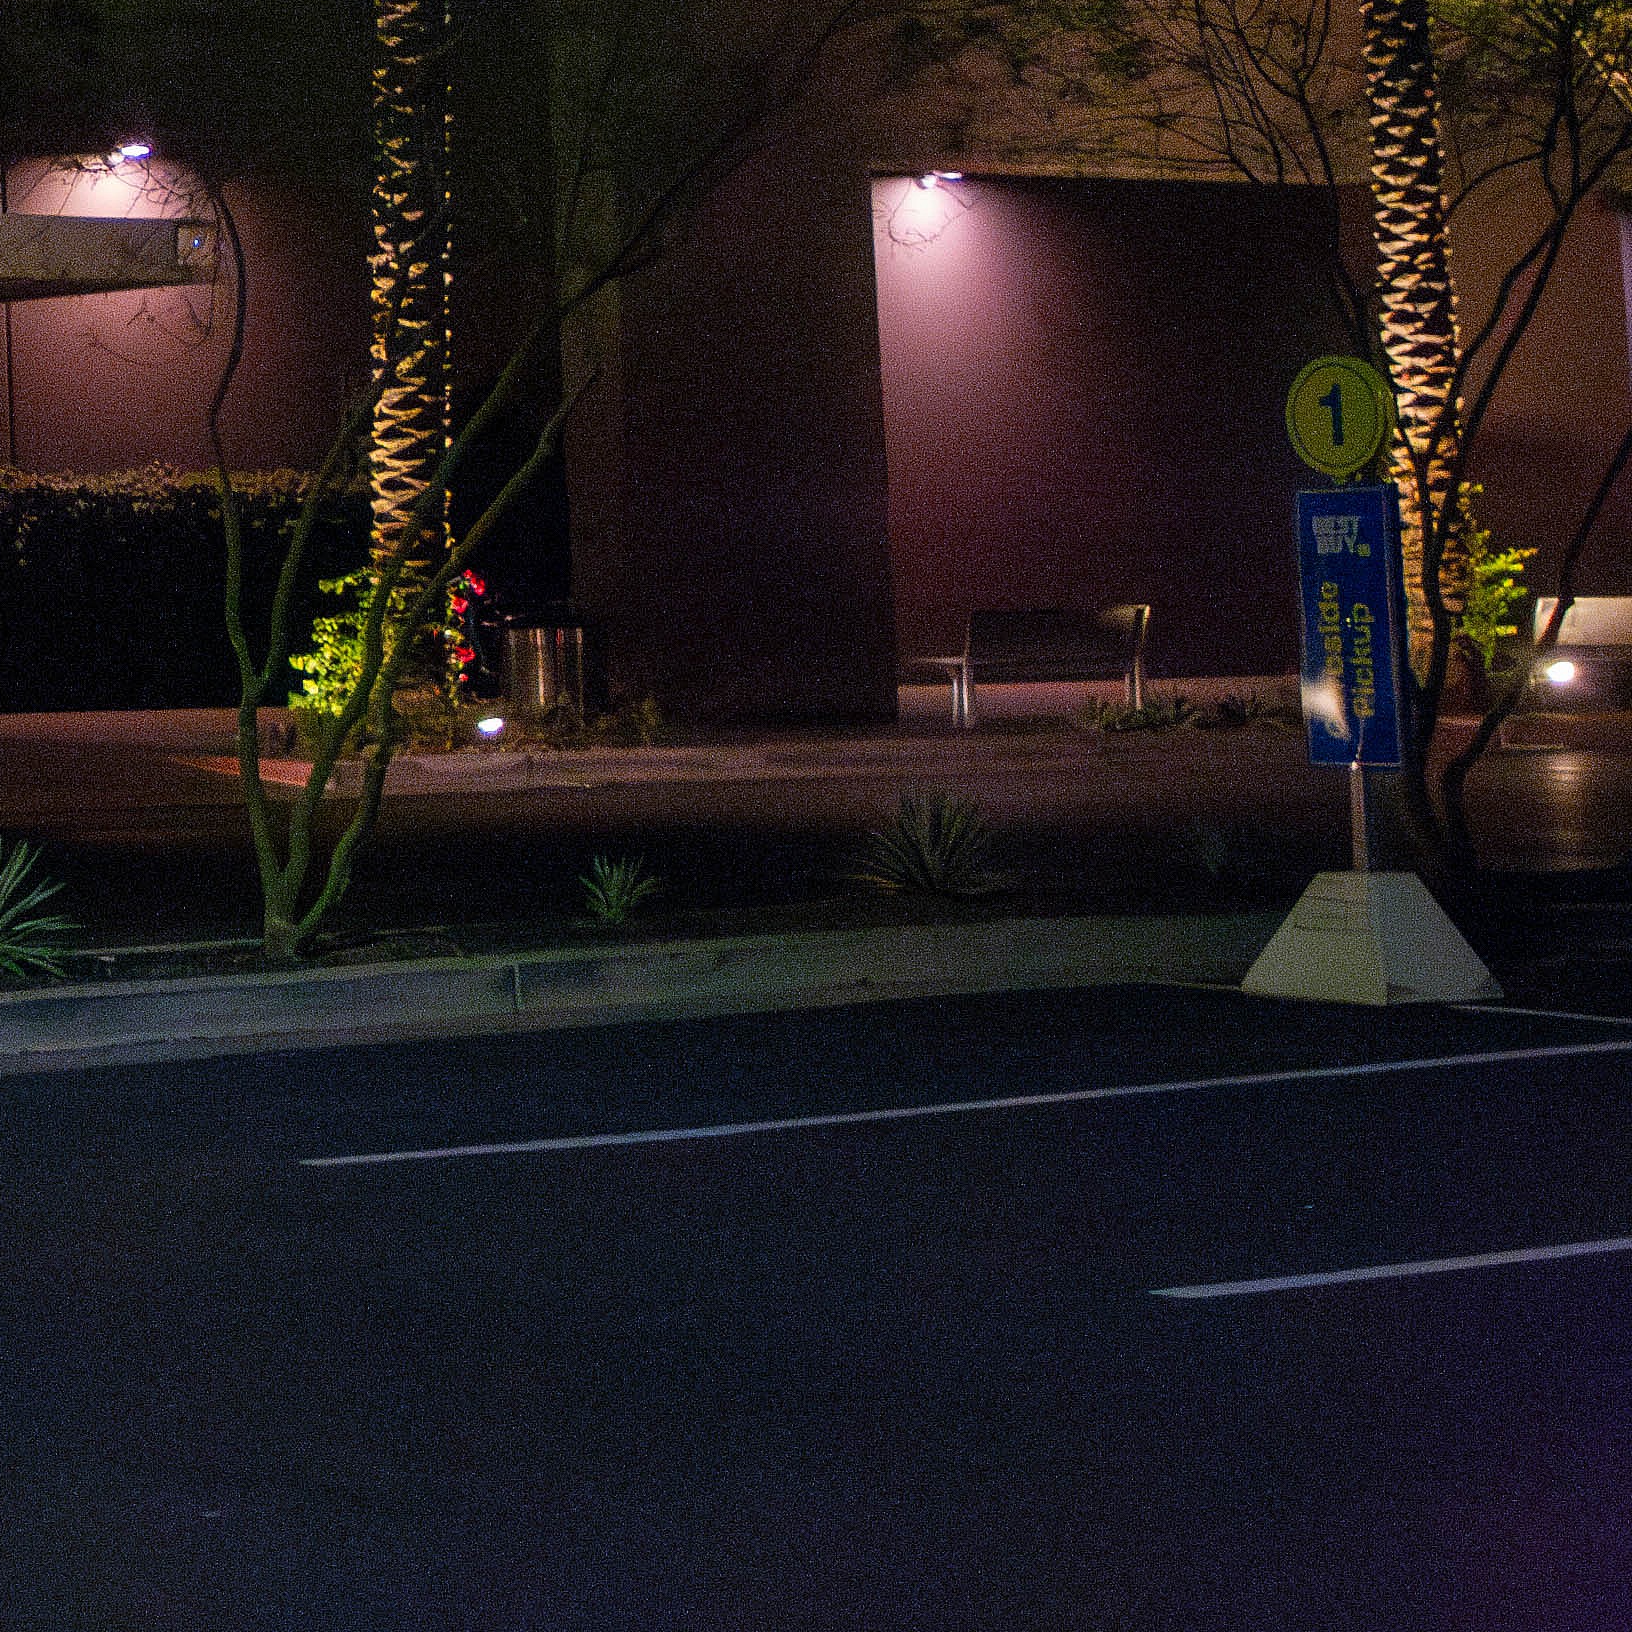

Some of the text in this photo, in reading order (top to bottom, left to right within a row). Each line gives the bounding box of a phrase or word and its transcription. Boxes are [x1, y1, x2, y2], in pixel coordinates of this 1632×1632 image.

[1318, 382, 1345, 446] 1
[1311, 515, 1361, 535] BEST
[1315, 533, 1359, 555] BUY
[1350, 601, 1377, 720] Pickup
